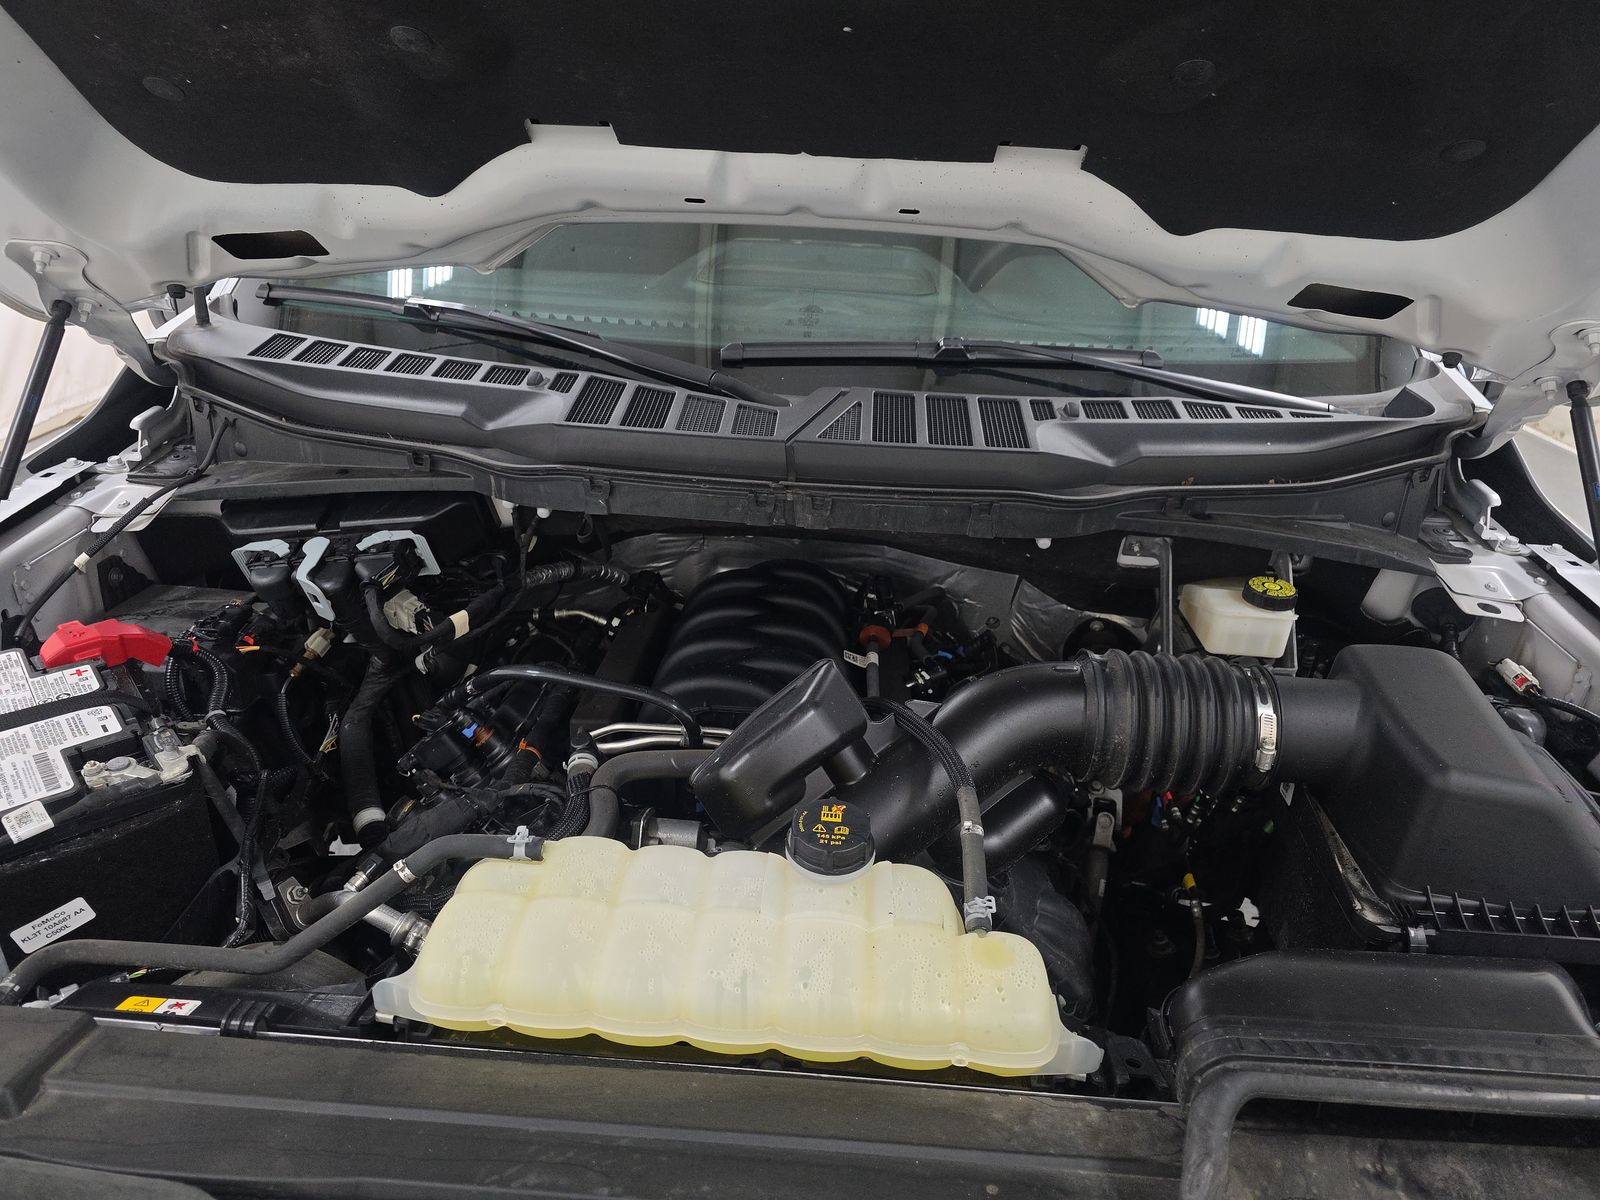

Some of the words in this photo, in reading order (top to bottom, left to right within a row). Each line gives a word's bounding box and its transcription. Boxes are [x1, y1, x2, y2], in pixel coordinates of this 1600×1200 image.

[20, 929, 42, 943] KL3T
[73, 907, 86, 916] AA
[31, 910, 66, 930] FoMoCo
